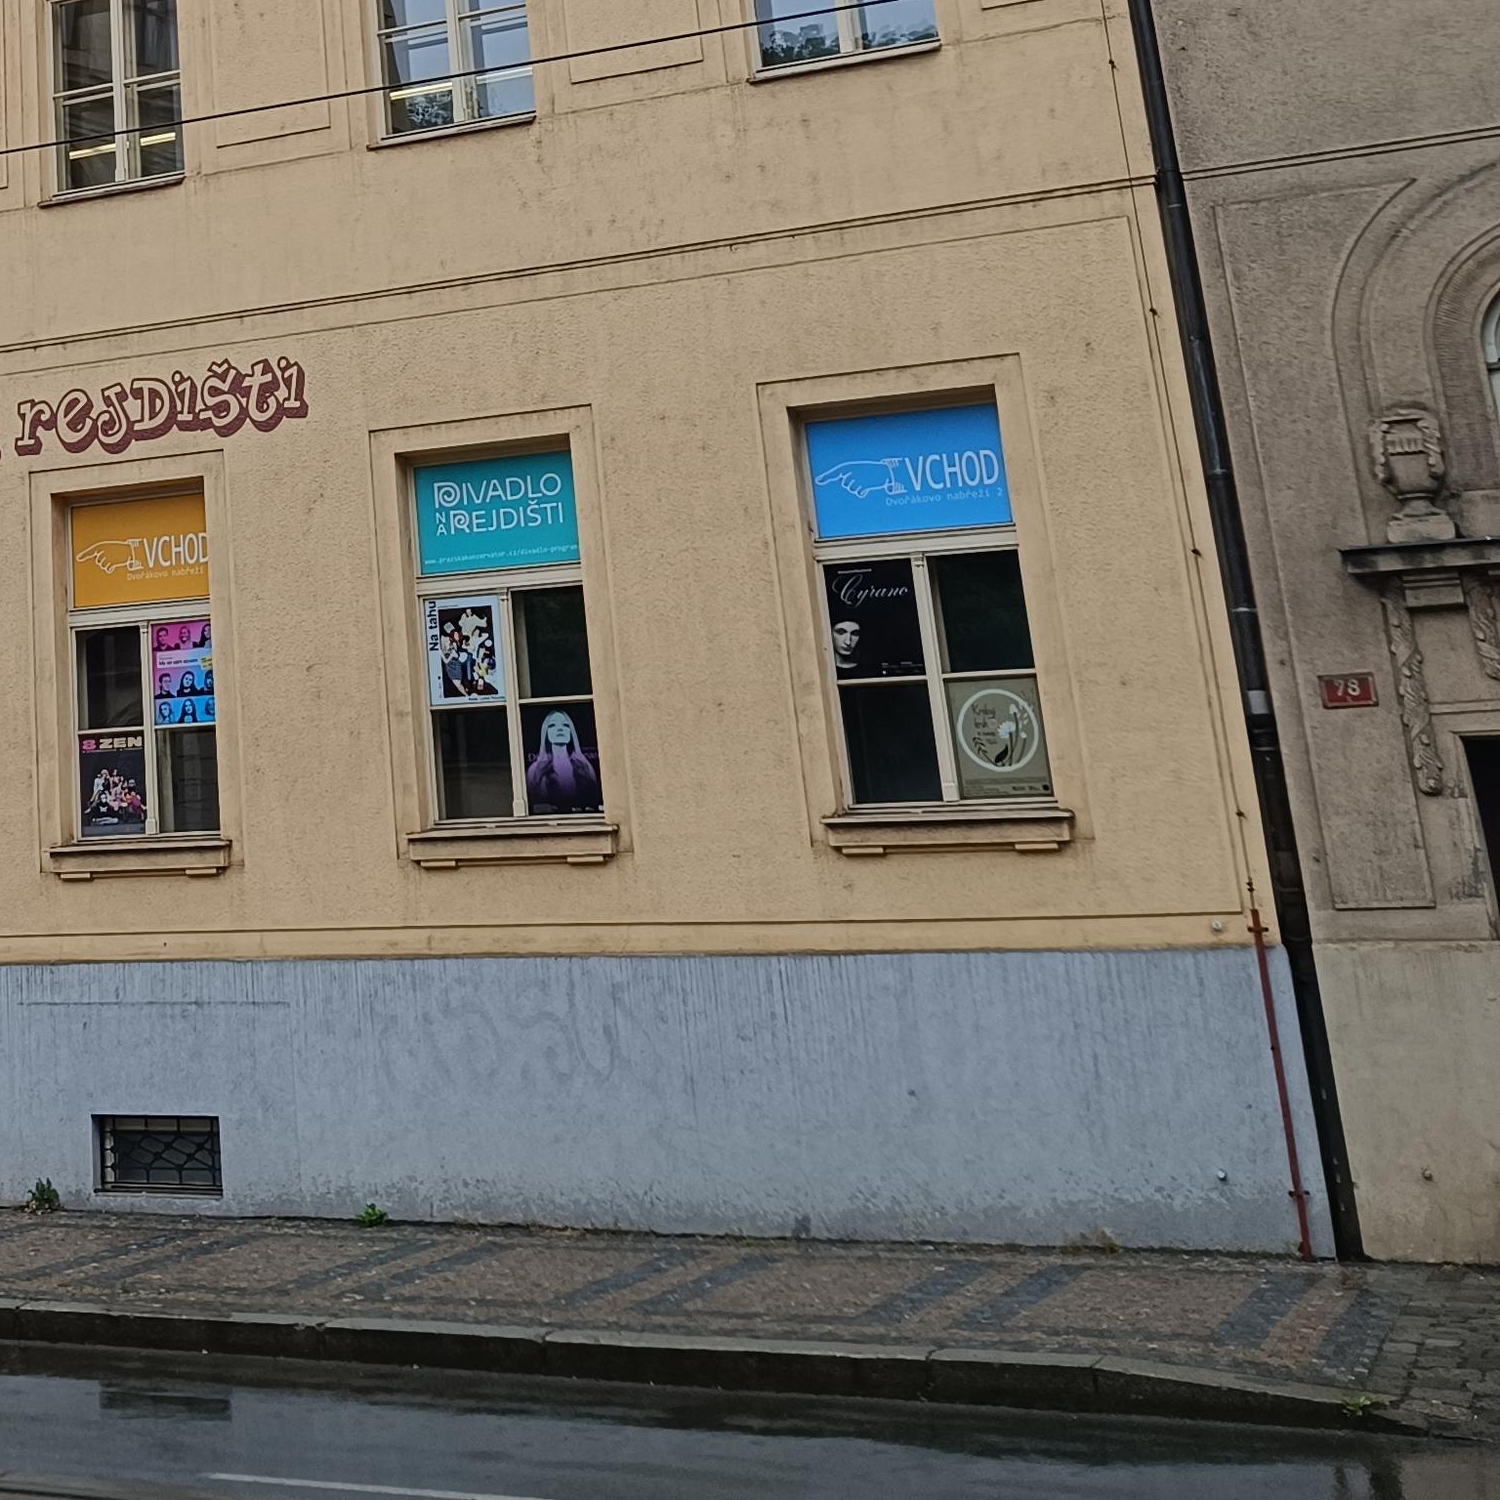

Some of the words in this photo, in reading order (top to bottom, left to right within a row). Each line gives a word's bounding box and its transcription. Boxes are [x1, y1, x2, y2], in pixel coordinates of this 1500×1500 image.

[904, 449, 1000, 491] VCHOD
[434, 473, 562, 509] DIVADLO
[449, 500, 564, 535] REJDIŠTI
[143, 532, 209, 568] VCHOD
[832, 574, 908, 608] Cyrano
[427, 601, 438, 630] tahu
[429, 634, 439, 651] Na
[1333, 679, 1361, 696] 78
[82, 739, 97, 750] 8
